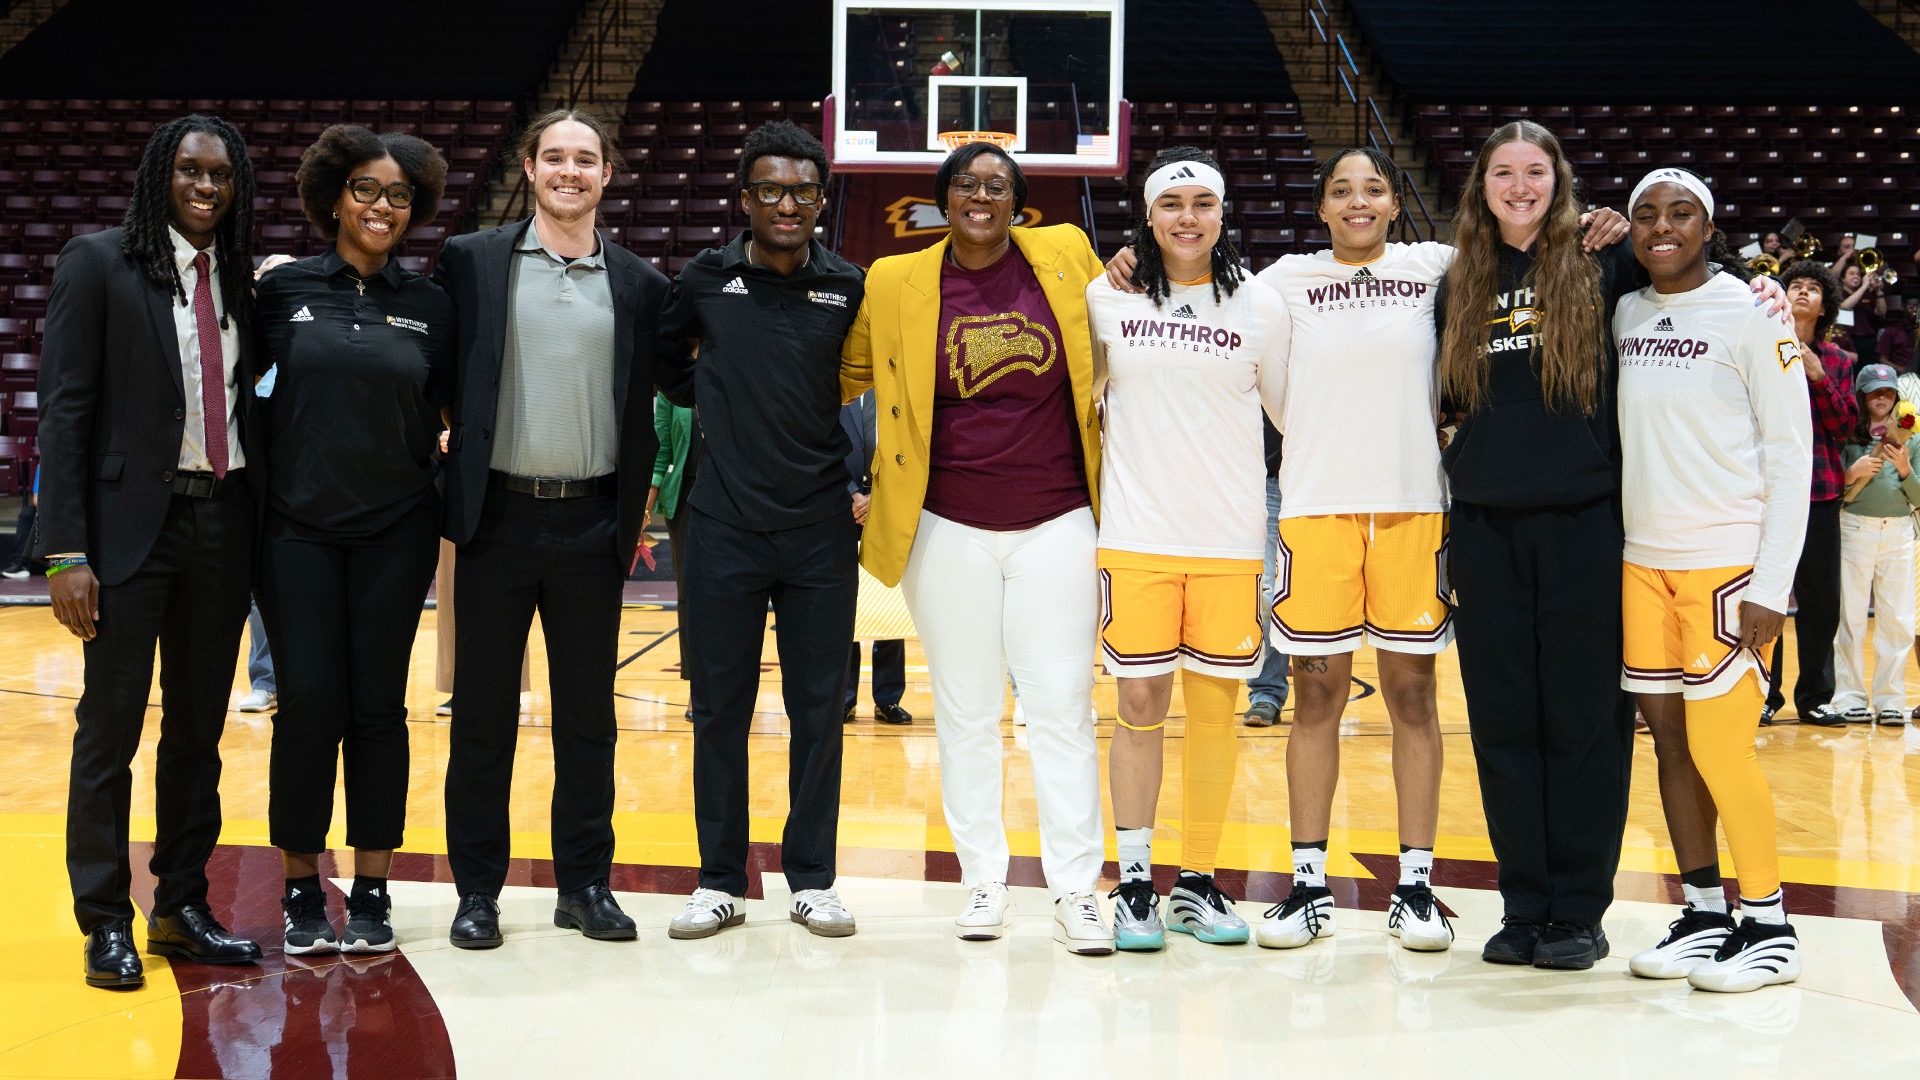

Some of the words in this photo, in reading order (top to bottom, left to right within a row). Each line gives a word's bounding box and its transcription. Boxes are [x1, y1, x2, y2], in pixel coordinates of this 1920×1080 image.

[723, 286, 749, 295] adidas
[816, 291, 847, 303] WINTHROP
[1307, 279, 1427, 306] WINTHROP
[1317, 299, 1418, 313] BASKETBALL
[395, 315, 428, 330] WINTHROP
[1171, 311, 1197, 320] adidas
[1120, 319, 1242, 351] WINTHROP
[1128, 339, 1230, 360] BASKETBALL
[1620, 337, 1709, 359] WINTHROP
[1620, 358, 1691, 370] BASKETBALL
